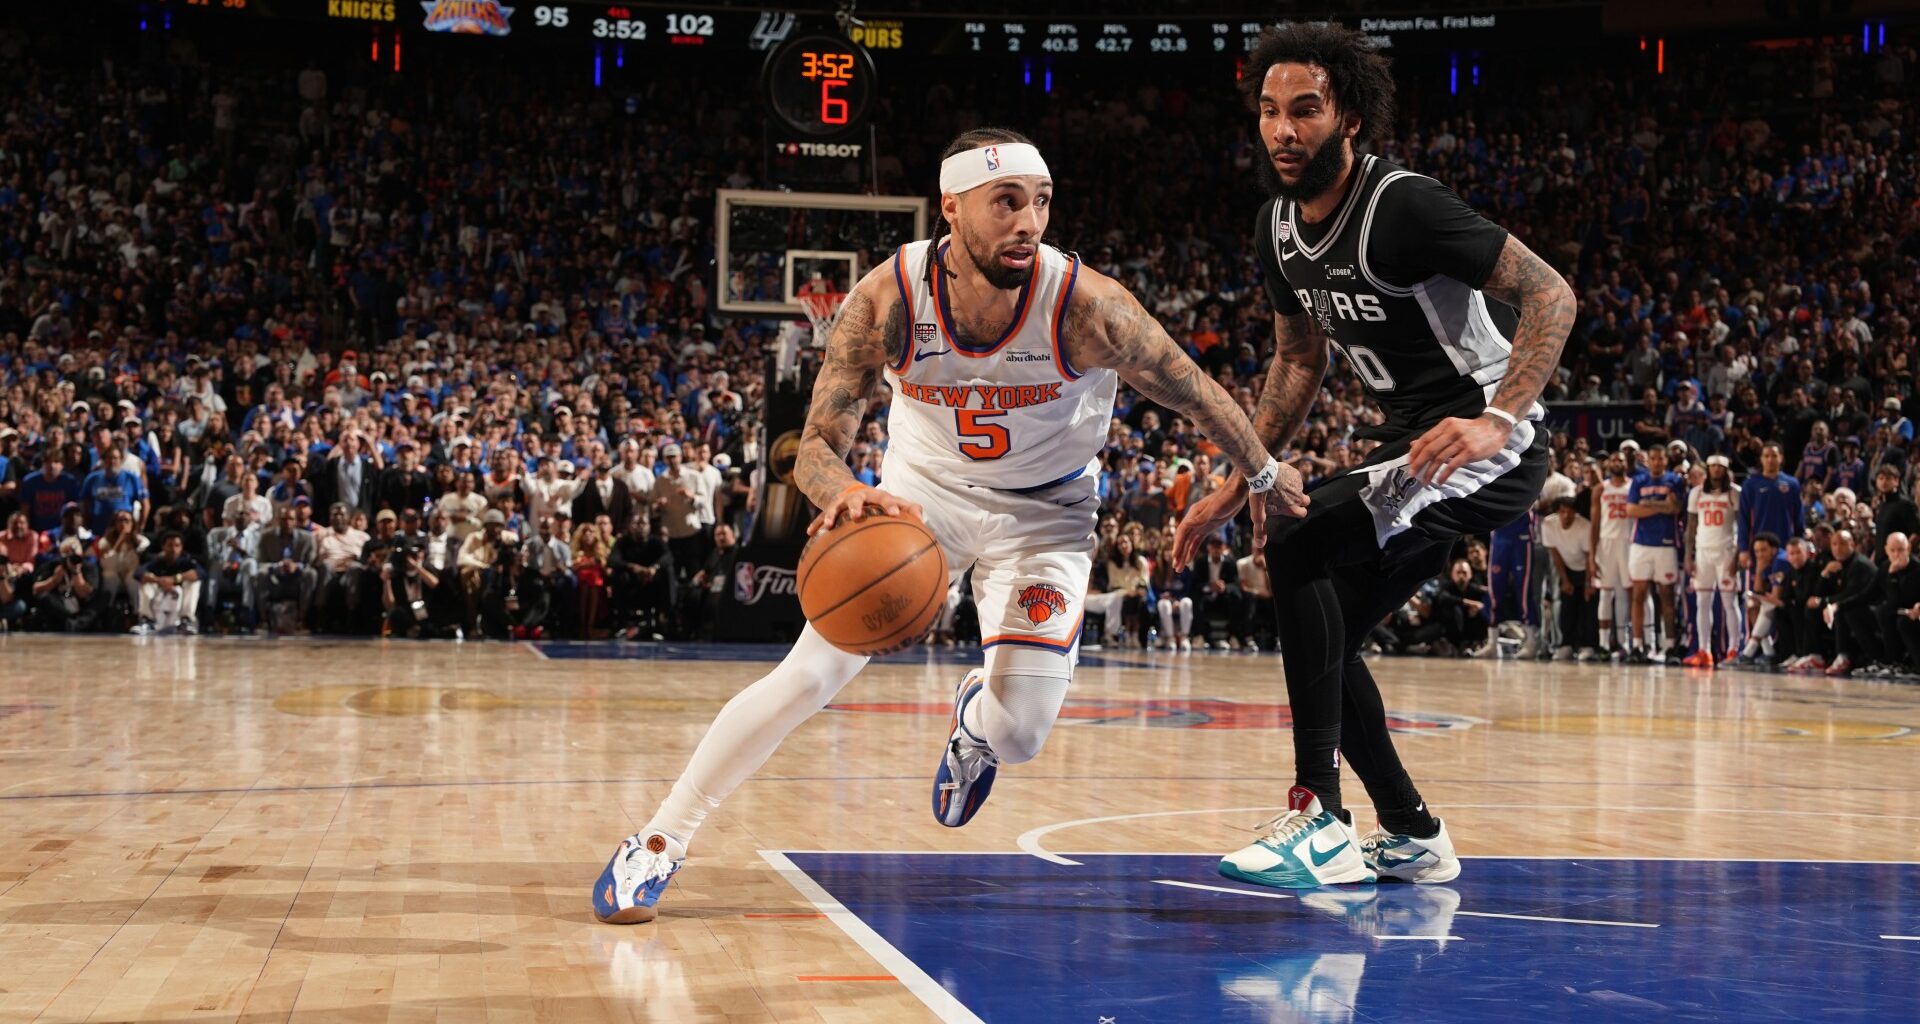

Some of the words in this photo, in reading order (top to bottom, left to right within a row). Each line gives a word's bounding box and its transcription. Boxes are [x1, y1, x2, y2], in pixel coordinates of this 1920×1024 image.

[327, 0, 396, 21] KNICKS
[533, 5, 569, 28] 95
[592, 18, 647, 40] 3:52
[665, 13, 714, 36] 102
[1360, 17, 1414, 31] De'Aaron
[1415, 16, 1440, 29] Fox.
[1442, 15, 1469, 28] First
[1470, 14, 1496, 27] lead
[851, 27, 903, 49] PURS
[970, 36, 982, 51] 1
[1007, 37, 1021, 52] 2
[1041, 37, 1079, 52] 40.5
[1095, 37, 1134, 52] 42.7
[1150, 37, 1188, 52] 93.8
[1212, 37, 1226, 52] 9
[802, 52, 854, 79] 3:52
[821, 80, 849, 124] 6
[799, 142, 862, 158] TISSOT
[1328, 267, 1352, 277] LEDGER
[1294, 288, 1388, 326] PURS
[1006, 354, 1023, 362] abu
[1025, 353, 1051, 362] dhabi
[900, 379, 972, 408] NEW
[974, 381, 1063, 410] YORK
[955, 408, 1012, 461] 5
[1596, 417, 1634, 439] UL
[1608, 503, 1628, 519] 25
[1704, 510, 1724, 527] 00
[744, 564, 798, 606] Fin
[1018, 586, 1067, 616] KNICKS
